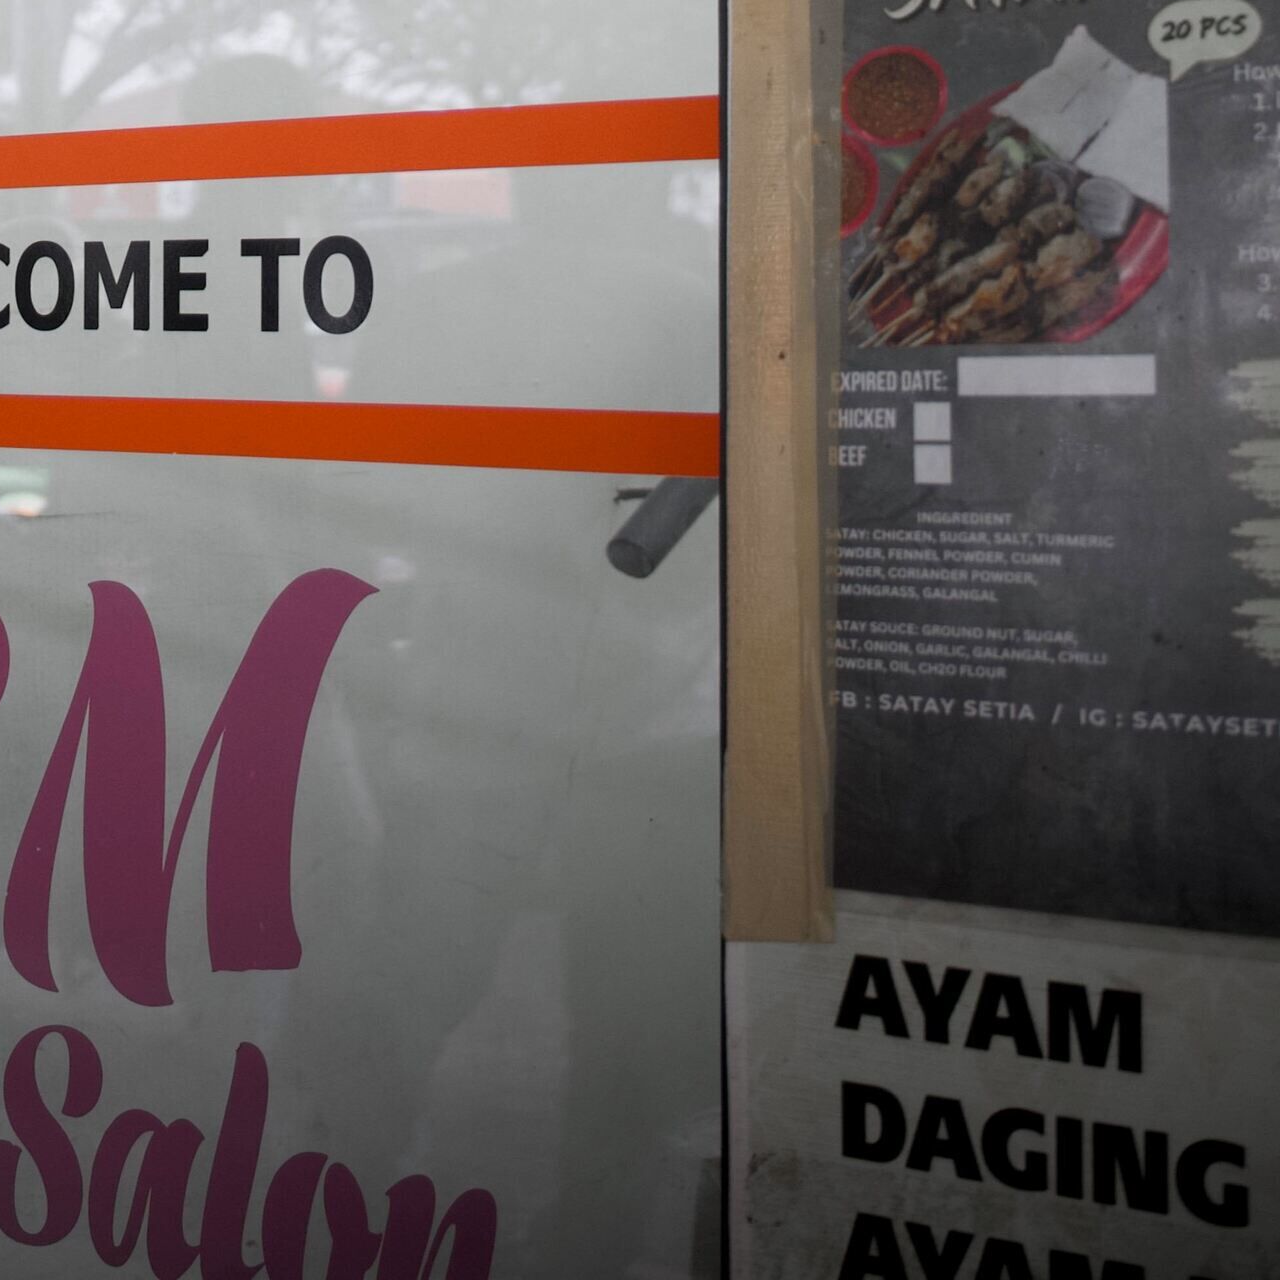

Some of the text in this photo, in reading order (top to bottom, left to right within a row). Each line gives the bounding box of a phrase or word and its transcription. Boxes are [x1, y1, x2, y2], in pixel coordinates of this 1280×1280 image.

[1160, 13, 1248, 43] 20 PCS
[240, 234, 375, 335] TO
[830, 369, 949, 393] EXPIRED DATE:
[827, 407, 897, 429] CHICKEN
[828, 445, 868, 467] BEEF
[959, 663, 1008, 680] FLOUR
[828, 690, 857, 710] FB
[878, 692, 956, 717] SATAY
[963, 698, 1036, 722] SETIA
[1079, 706, 1107, 727] IG
[1132, 710, 1280, 738] SATAYSET
[833, 953, 1144, 1074] AYAM
[840, 1080, 1251, 1228] DAGING
